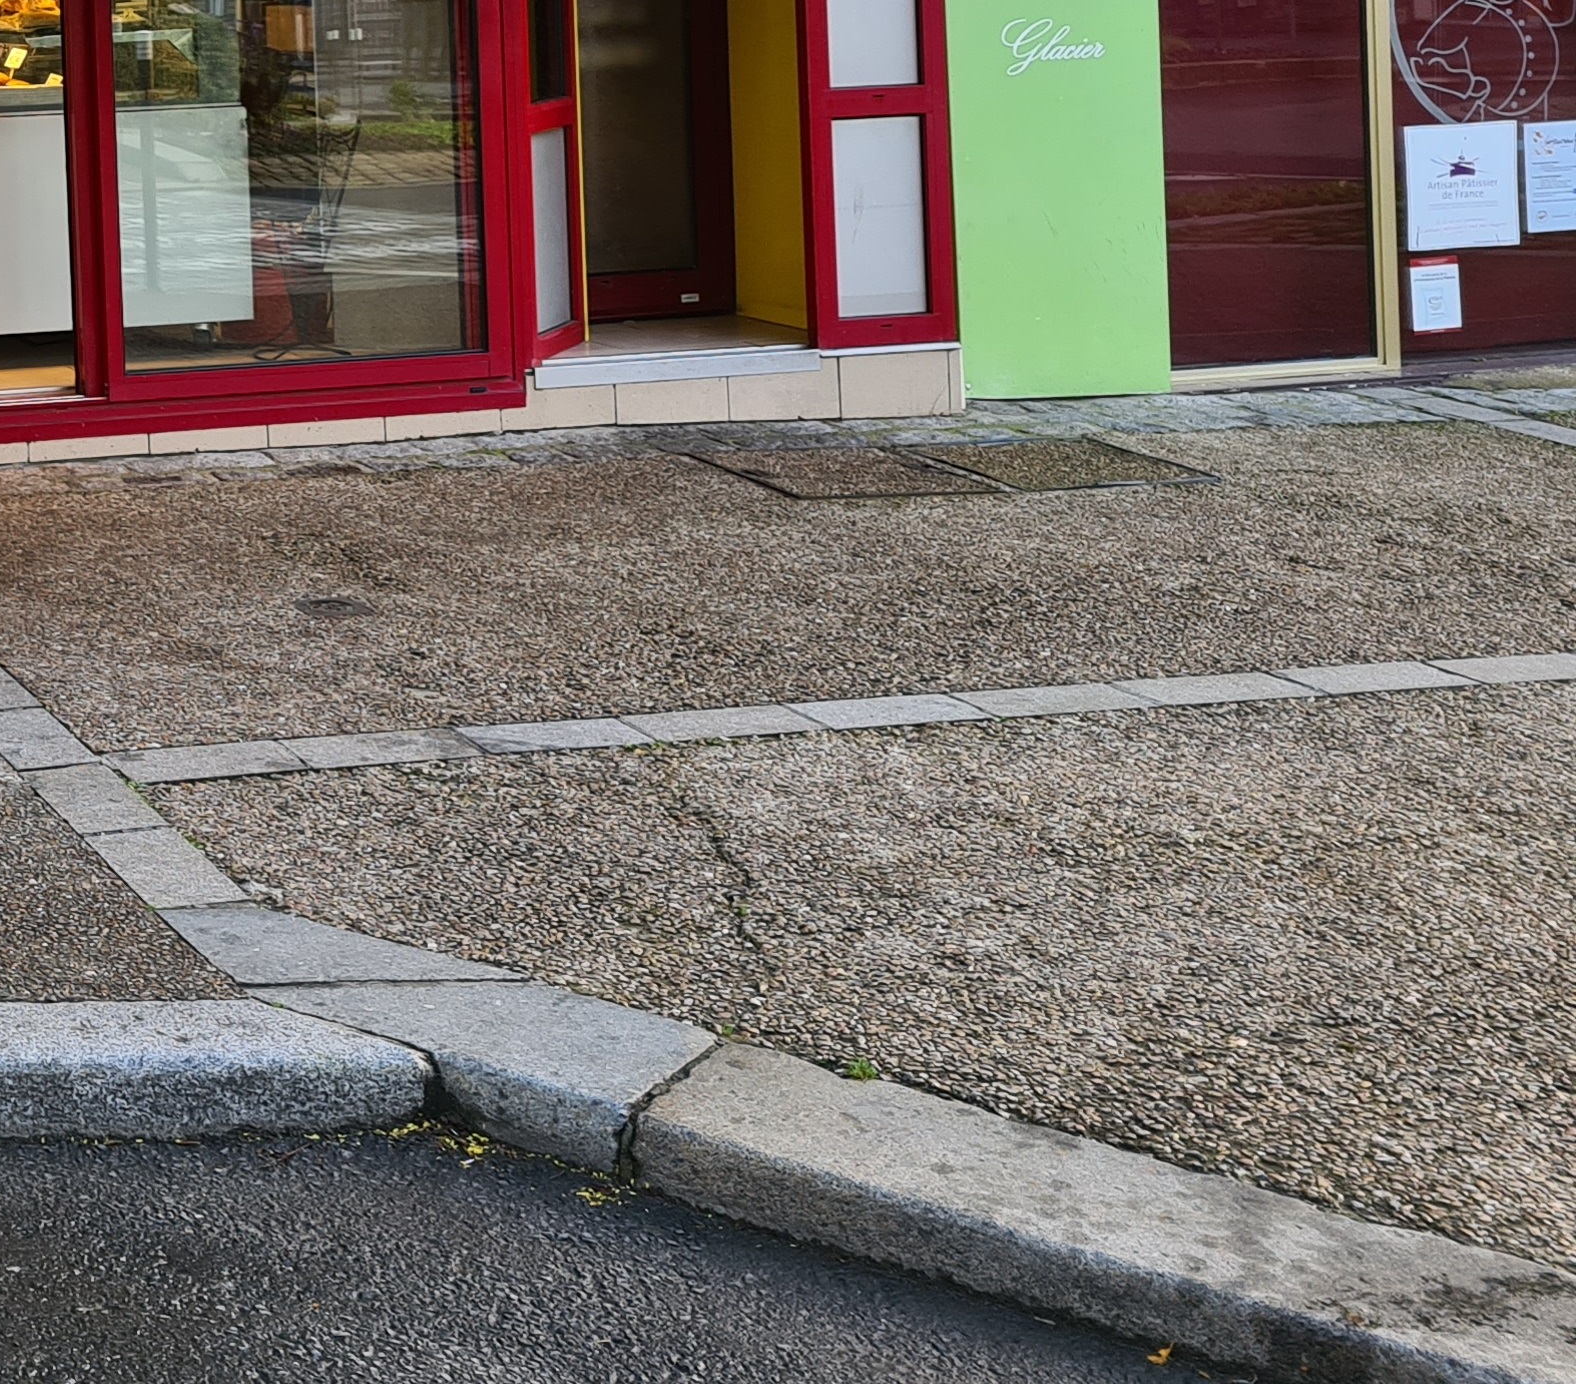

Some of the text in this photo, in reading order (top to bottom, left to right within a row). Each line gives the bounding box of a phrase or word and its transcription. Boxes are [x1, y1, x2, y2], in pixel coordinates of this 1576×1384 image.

[1000, 18, 1106, 76] Glacier
[1427, 178, 1499, 191] Artisan Pâtissier
[1442, 189, 1485, 200] de France
